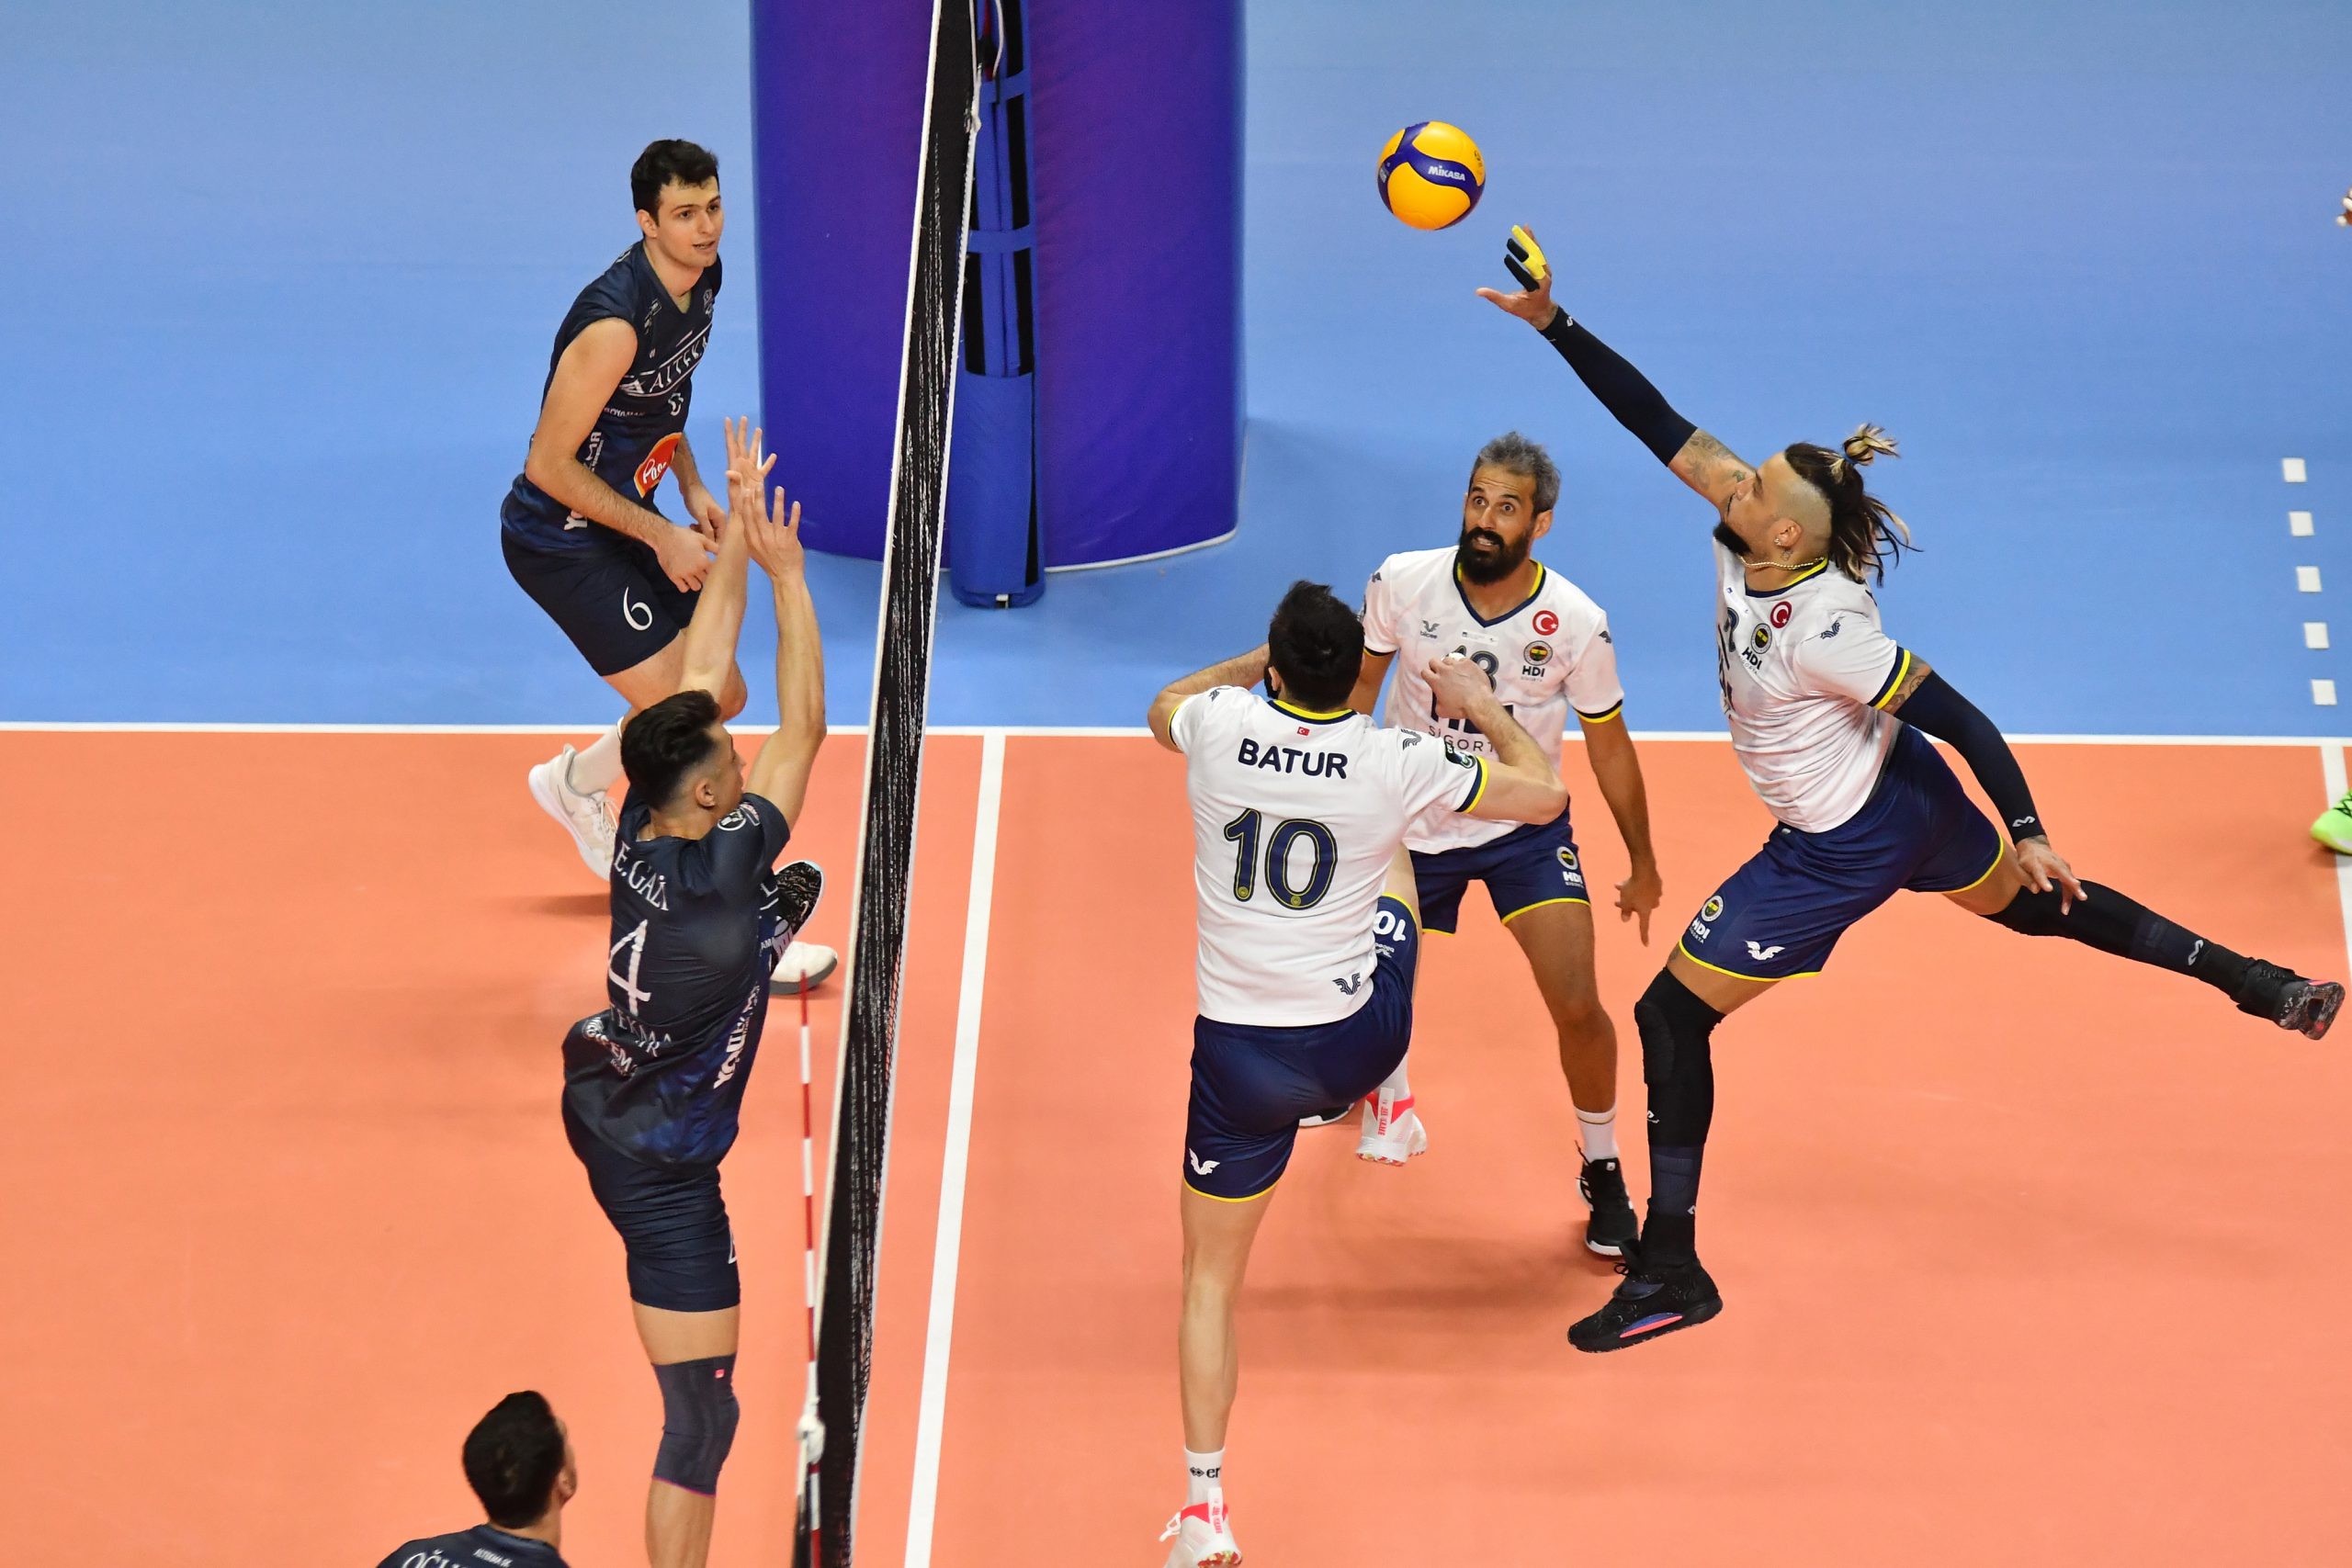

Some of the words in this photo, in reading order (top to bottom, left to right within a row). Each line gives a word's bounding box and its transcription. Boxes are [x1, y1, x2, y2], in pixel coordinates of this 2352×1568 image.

[623, 586, 653, 631] 6
[1521, 665, 1545, 678] HDI
[1741, 646, 1763, 671] HDI
[1237, 738, 1349, 780] BATUR
[1224, 807, 1339, 910] 10
[608, 919, 651, 1017] 4
